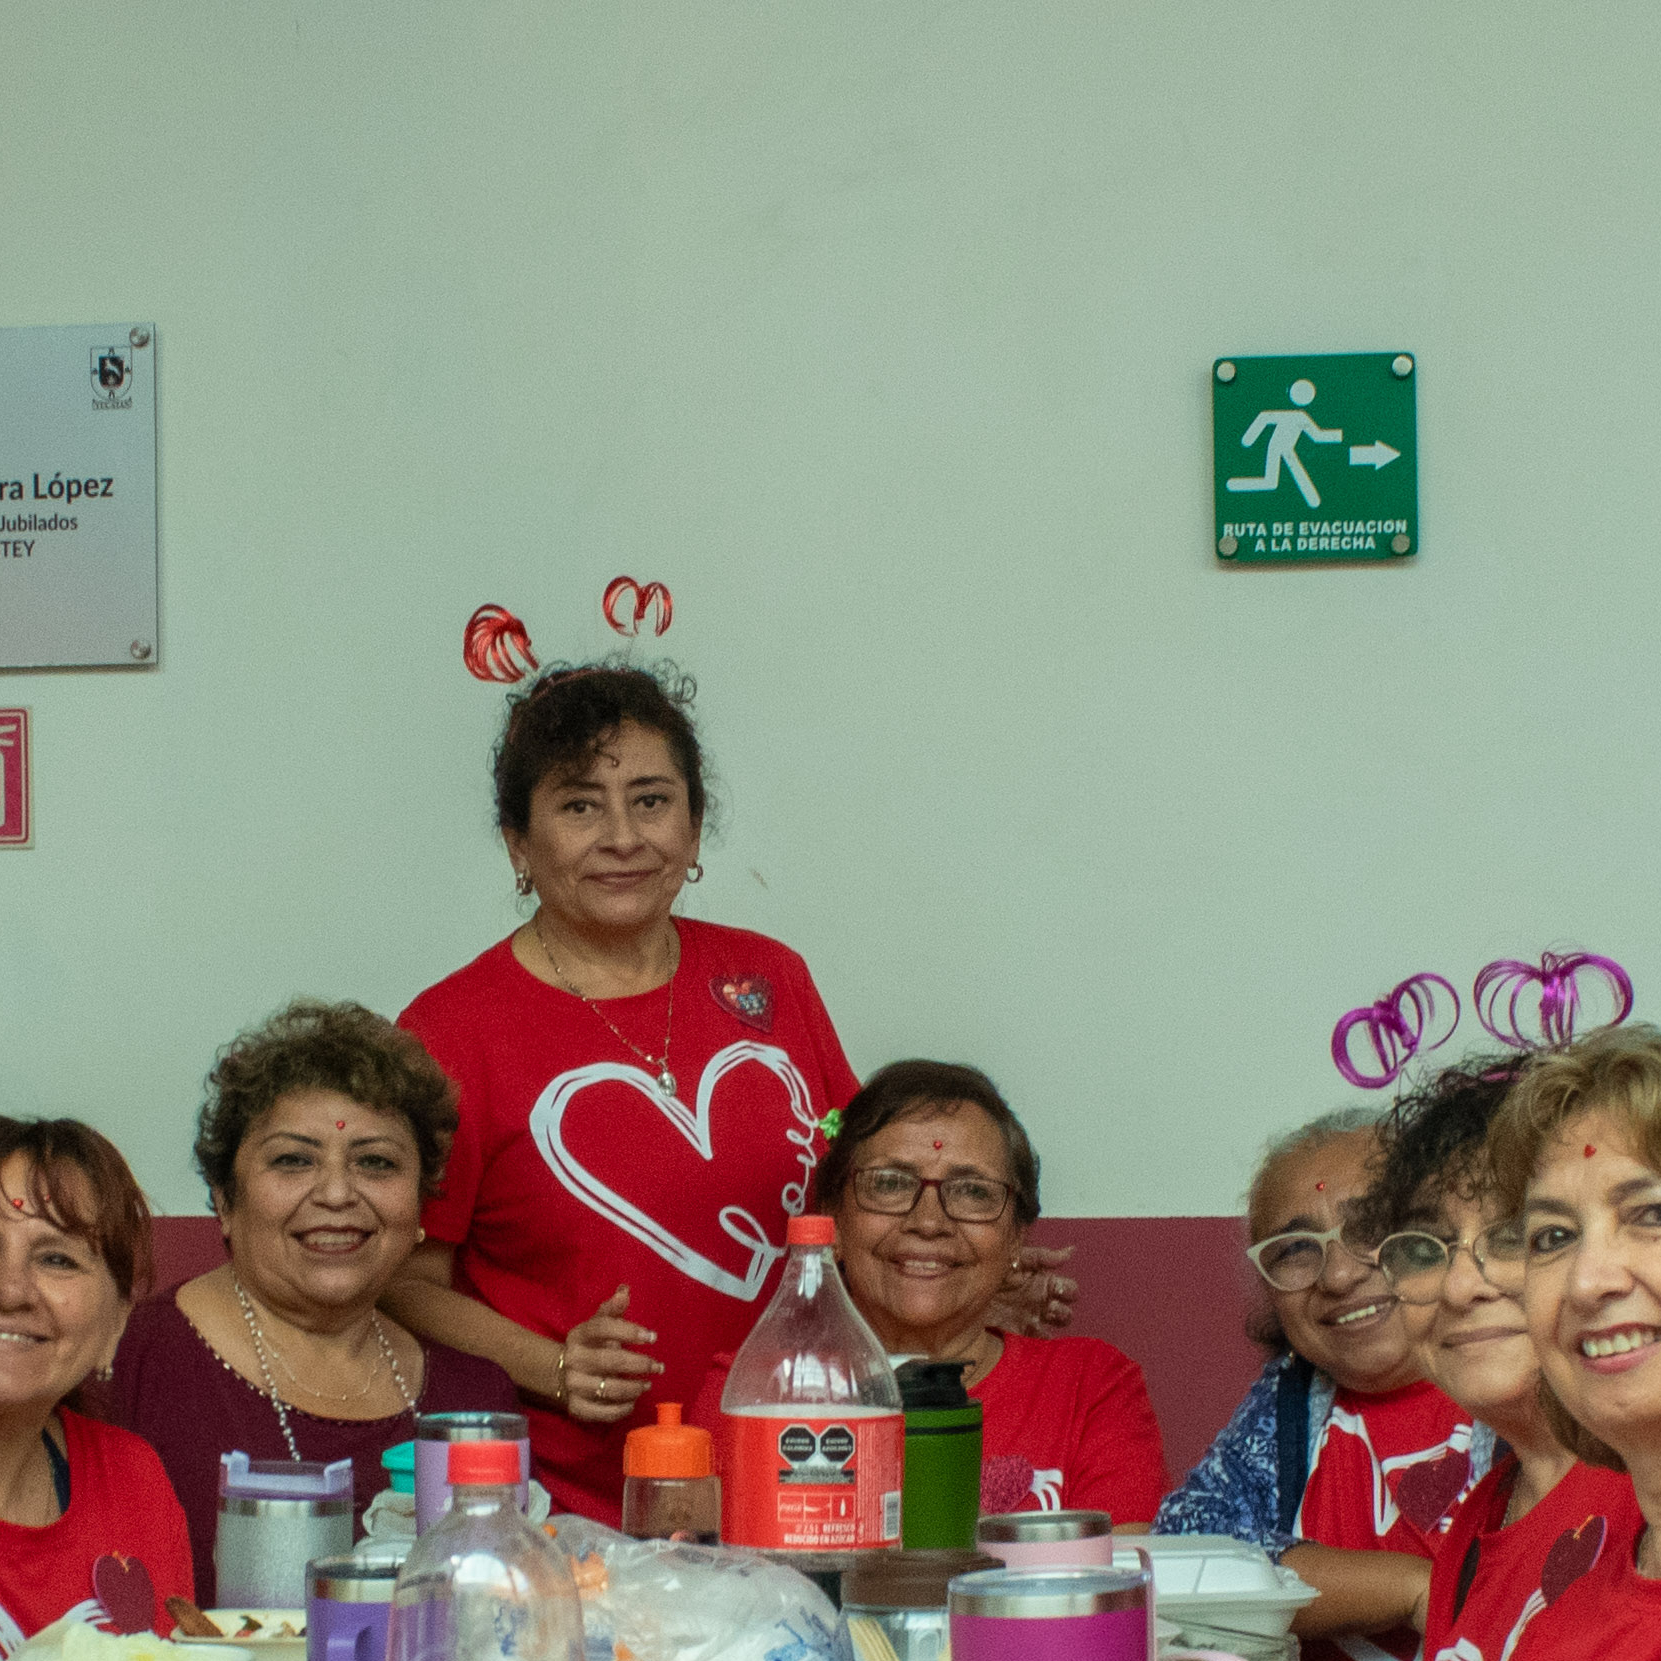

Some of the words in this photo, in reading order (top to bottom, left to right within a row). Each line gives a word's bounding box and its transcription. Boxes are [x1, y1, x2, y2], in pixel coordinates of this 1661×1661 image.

[33, 471, 114, 504] López
[1224, 522, 1267, 537] RUTA
[1272, 521, 1294, 536] DE
[1299, 519, 1408, 536] EVACUACION
[1255, 538, 1266, 553] A
[1271, 537, 1292, 552] LA
[1297, 536, 1376, 552] DERECHA
